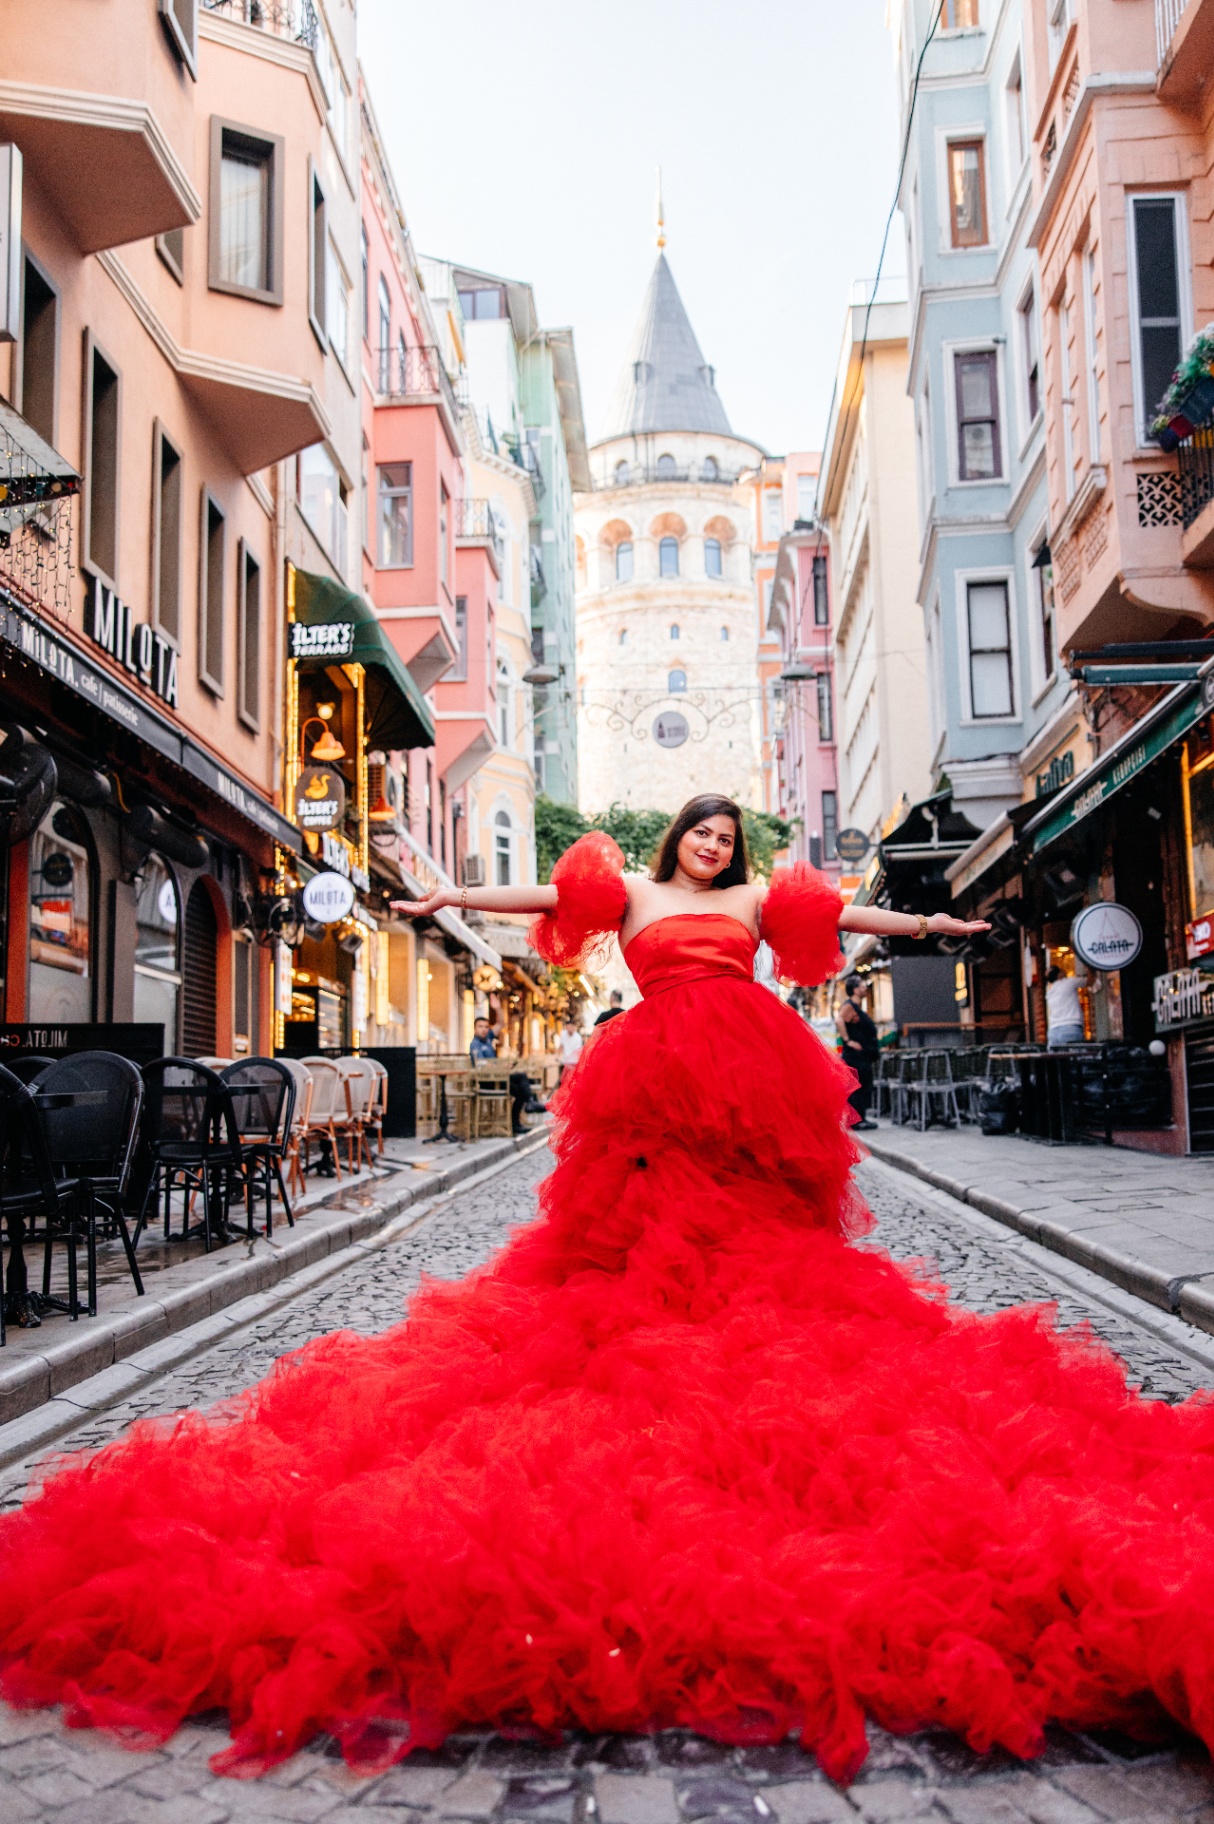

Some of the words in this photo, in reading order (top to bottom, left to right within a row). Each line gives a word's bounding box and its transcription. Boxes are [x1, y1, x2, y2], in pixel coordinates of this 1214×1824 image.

[94, 577, 179, 710] MILOTA
[310, 890, 346, 906] MILOTA
[1089, 938, 1134, 955] GALATA
